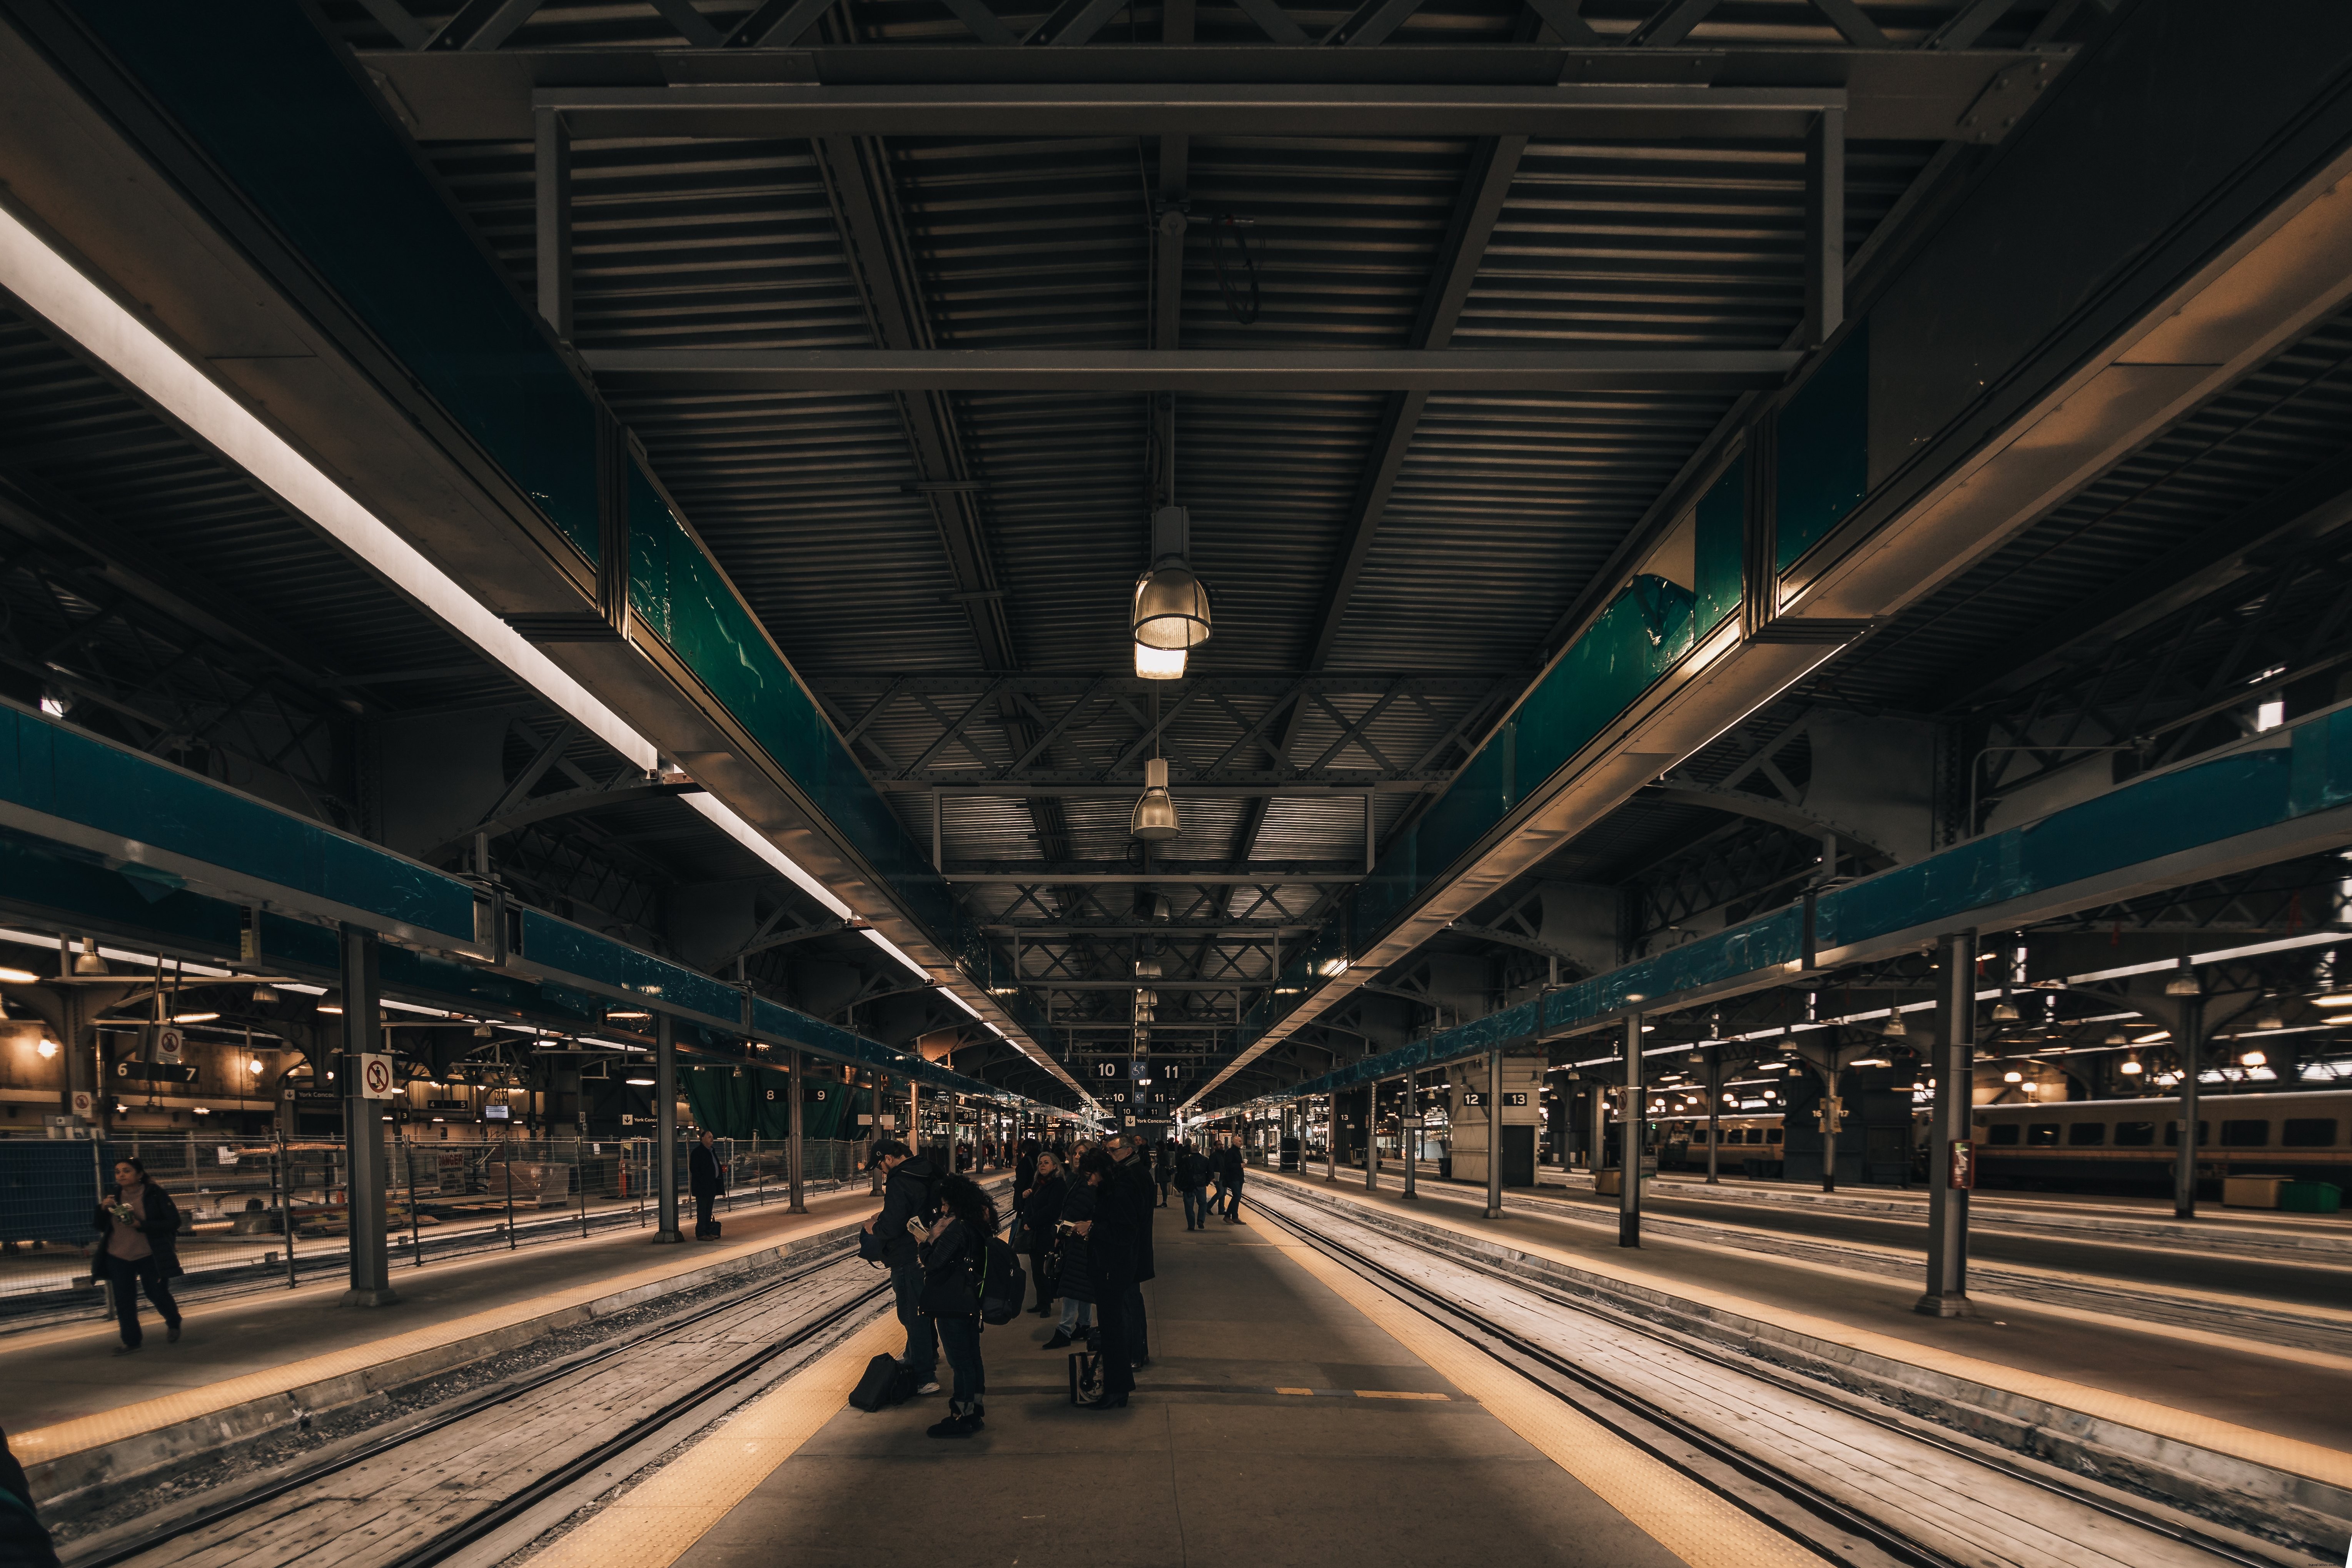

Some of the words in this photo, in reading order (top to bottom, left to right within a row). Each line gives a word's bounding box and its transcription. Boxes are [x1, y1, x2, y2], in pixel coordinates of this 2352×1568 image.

[117, 1063, 128, 1076] 6
[186, 1068, 196, 1080] 7
[1098, 1063, 1115, 1076] 10
[1165, 1065, 1178, 1078] 11
[767, 1090, 774, 1100] 8
[818, 1090, 825, 1100] 9
[1113, 1093, 1124, 1102] 10
[1155, 1094, 1163, 1102] 11
[1465, 1094, 1479, 1104] 12
[1512, 1094, 1525, 1104] 13
[438, 1154, 463, 1166] DANGER
